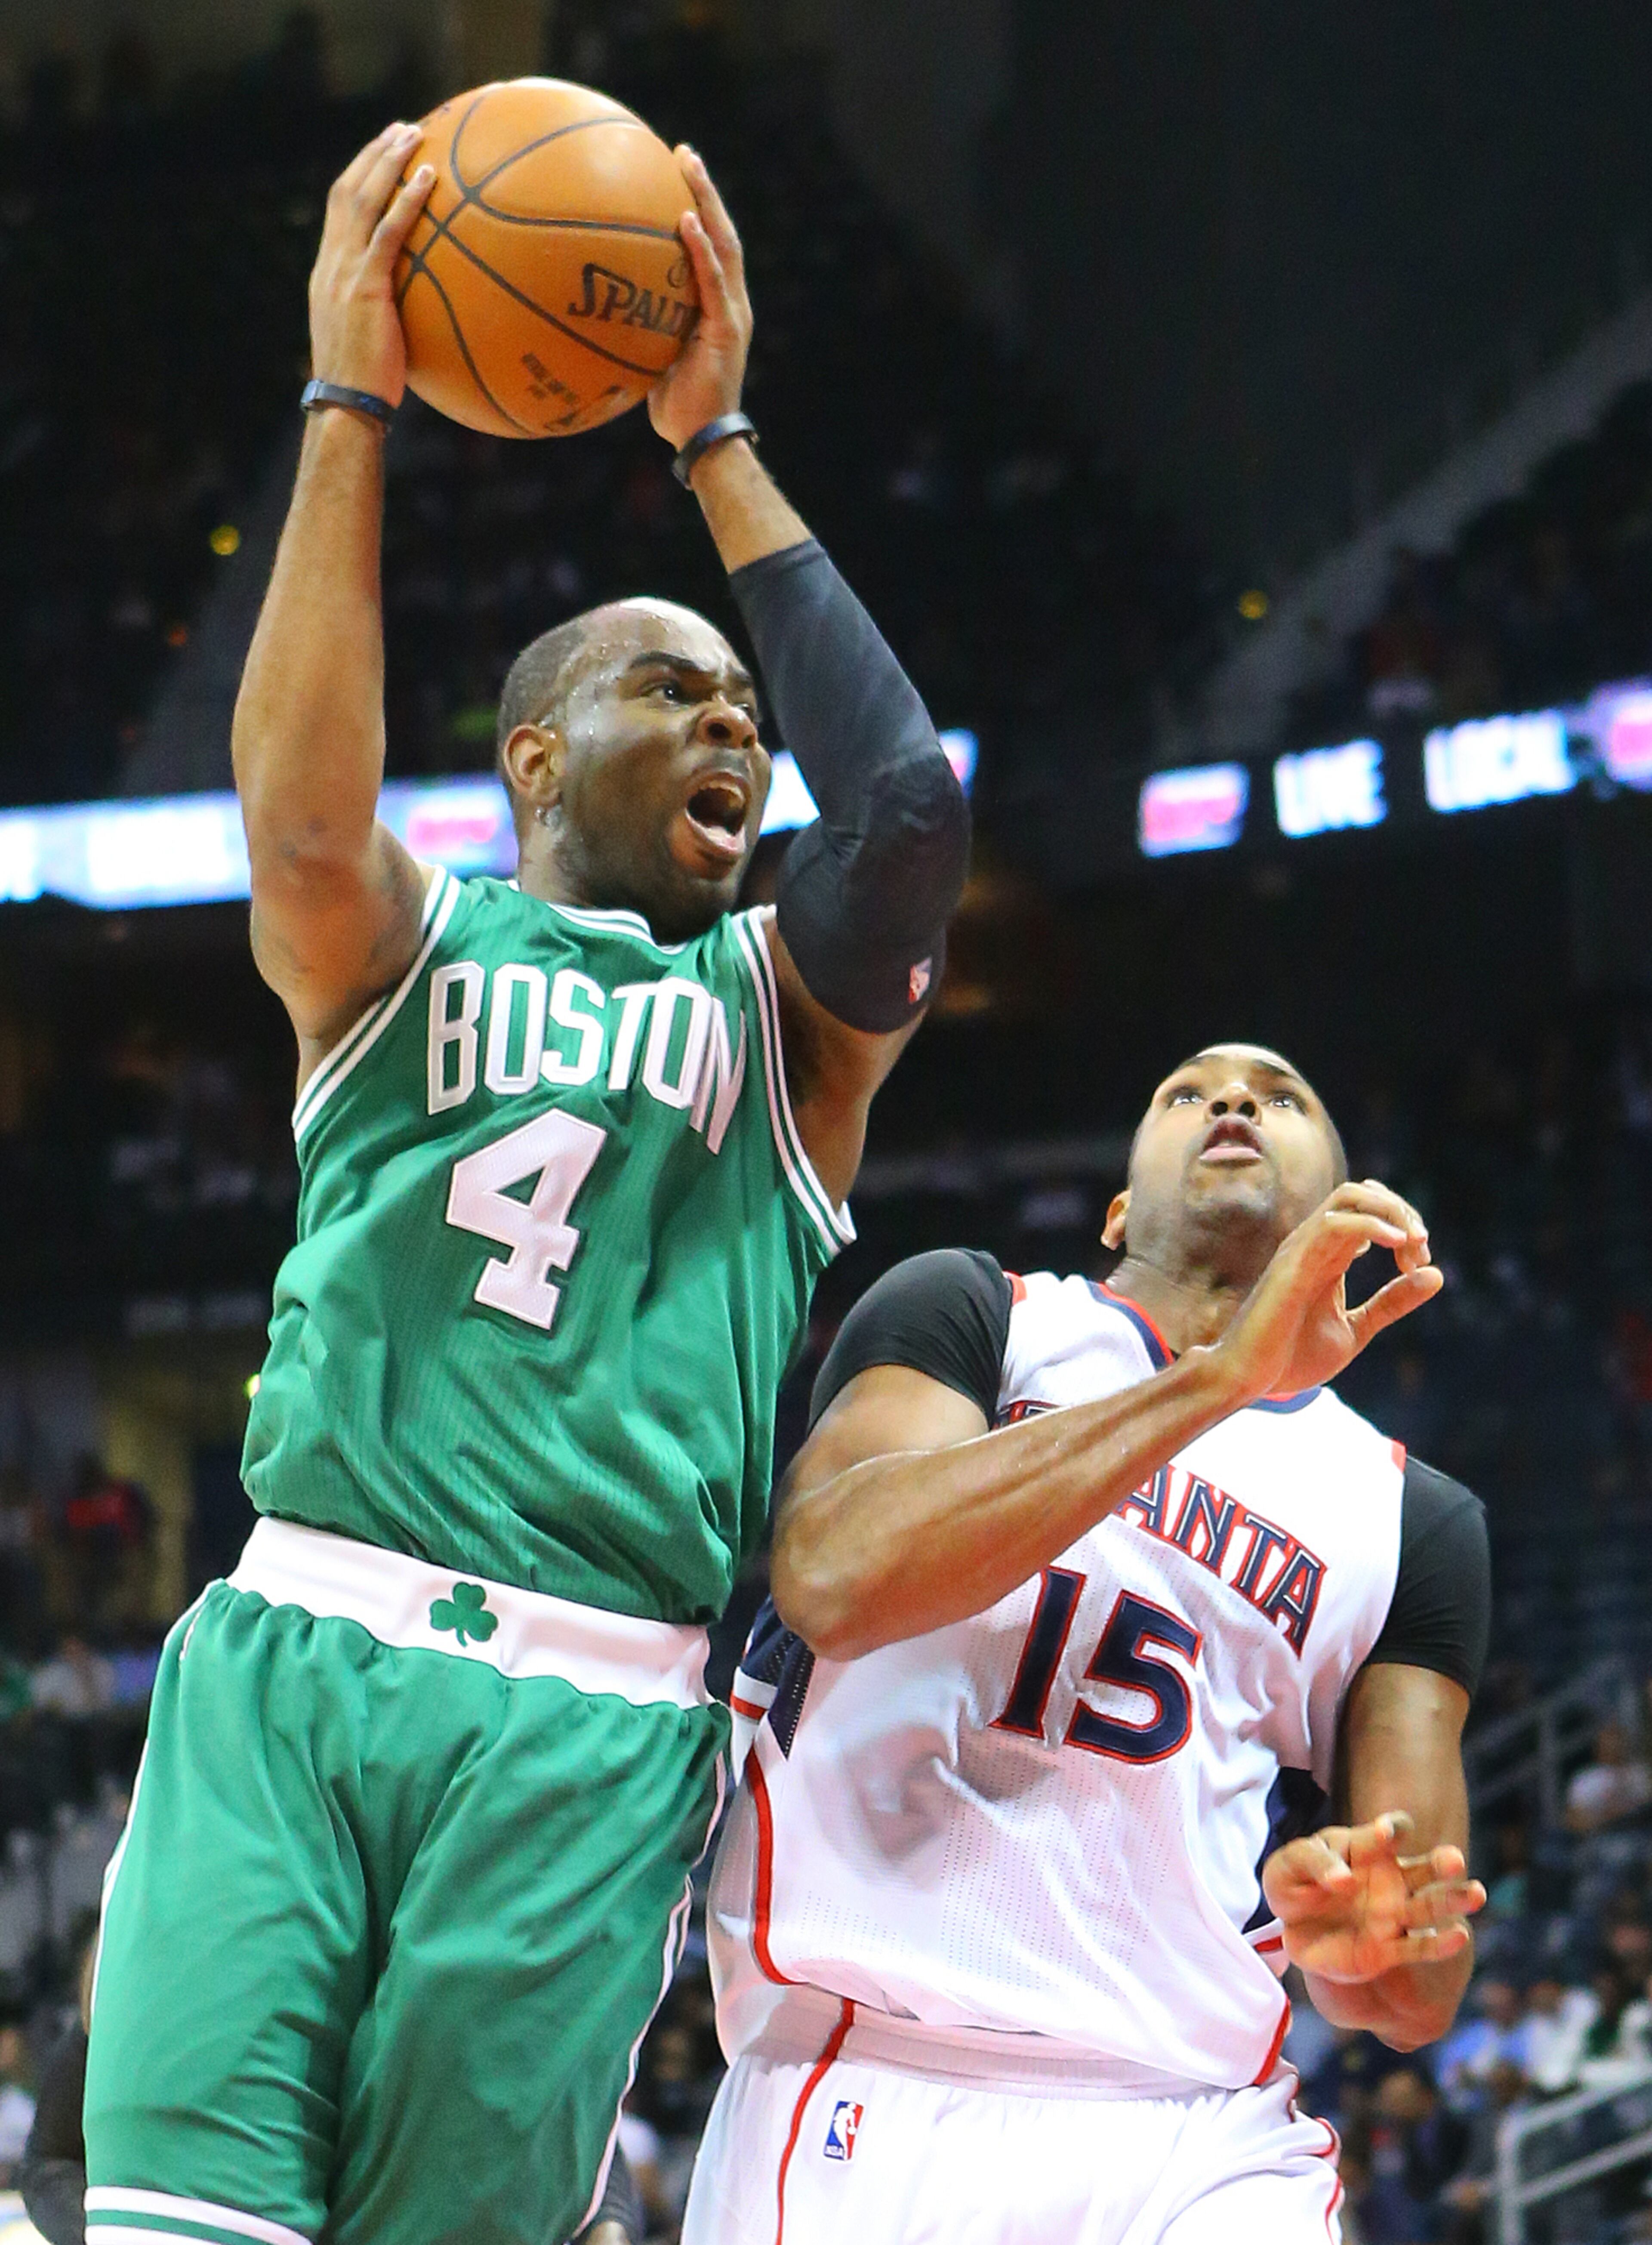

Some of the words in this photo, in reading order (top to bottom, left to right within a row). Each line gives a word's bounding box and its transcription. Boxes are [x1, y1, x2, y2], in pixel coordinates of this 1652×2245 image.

[428, 960, 747, 1155] BOSTON
[446, 1108, 607, 1330] 4
[988, 1566, 1203, 1765] 15
